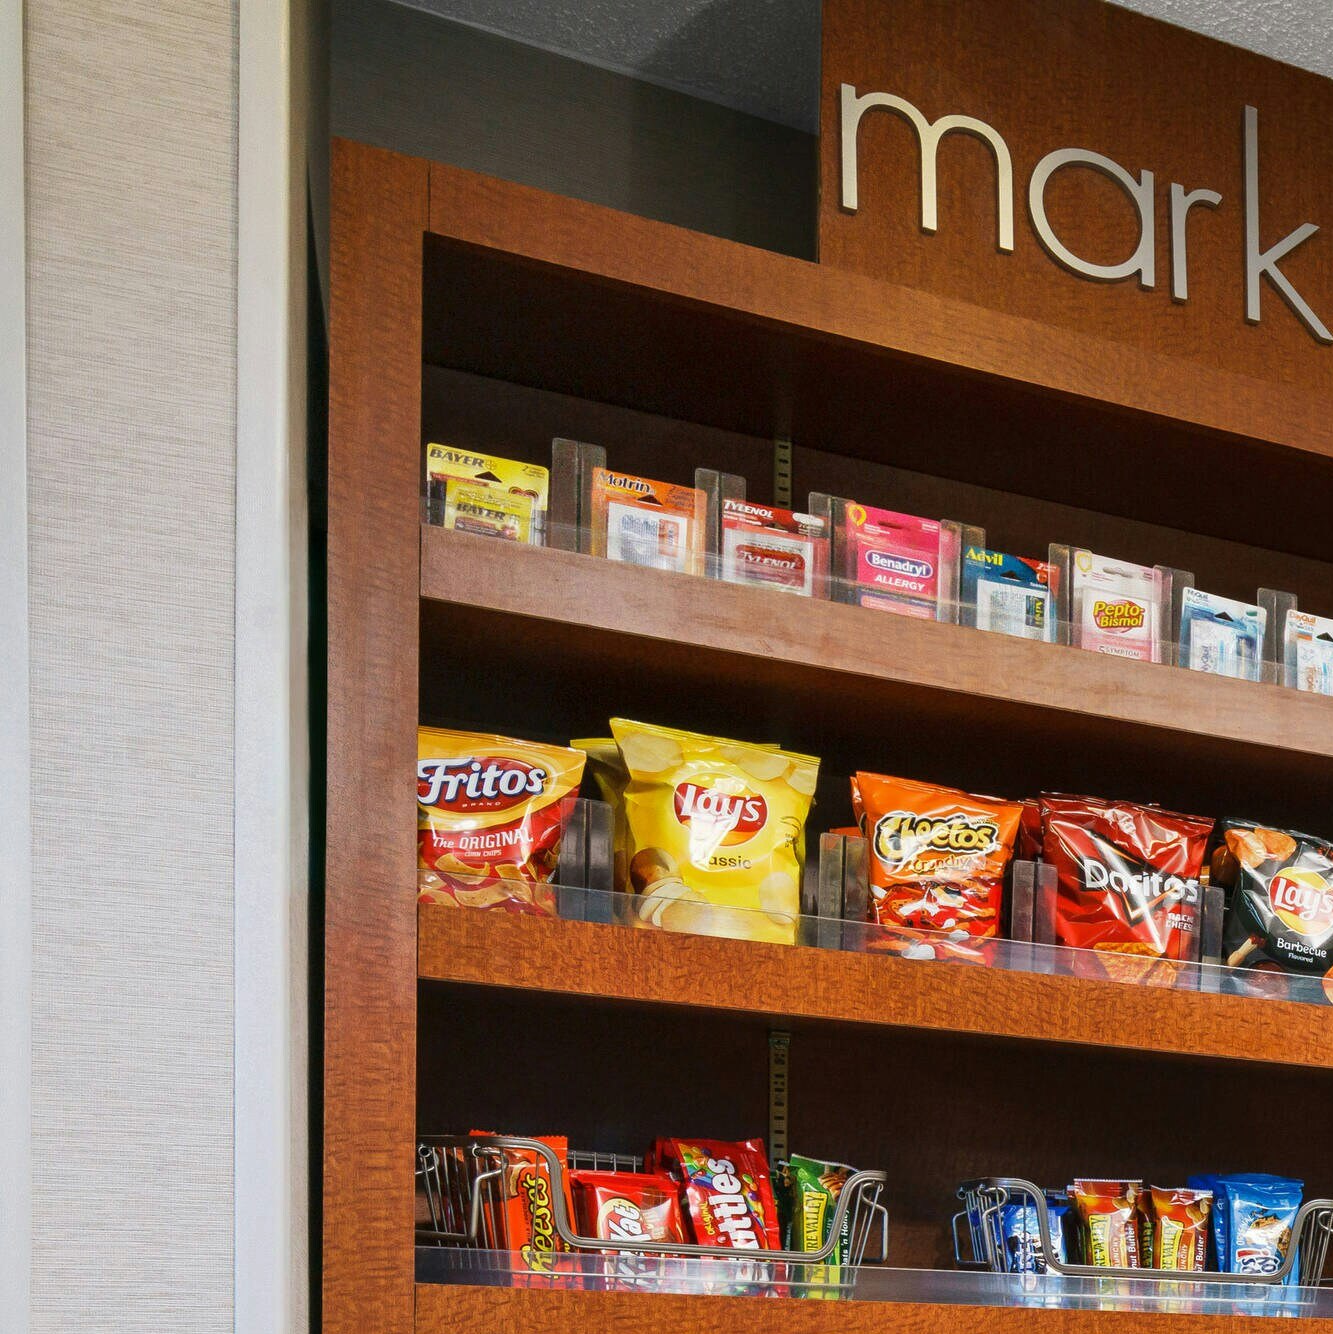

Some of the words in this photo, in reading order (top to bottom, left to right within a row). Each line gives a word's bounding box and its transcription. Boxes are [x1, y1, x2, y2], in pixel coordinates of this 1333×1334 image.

[429, 447, 484, 468] BAYER
[597, 470, 650, 494] Motrin
[456, 502, 505, 520] BAYER
[724, 500, 773, 519] TYLENOL
[871, 552, 927, 578] Benadryl
[965, 547, 1003, 566] Advil
[874, 574, 925, 592] ALLERGY
[1093, 600, 1145, 619] Pepto-
[1100, 613, 1143, 629] Bismol
[418, 756, 547, 804] Fritos
[433, 837, 454, 849] The
[459, 828, 534, 850] ORIGINAL
[708, 855, 752, 870] assic
[1085, 857, 1199, 903] Doritos
[1276, 937, 1328, 958] Barbecue
